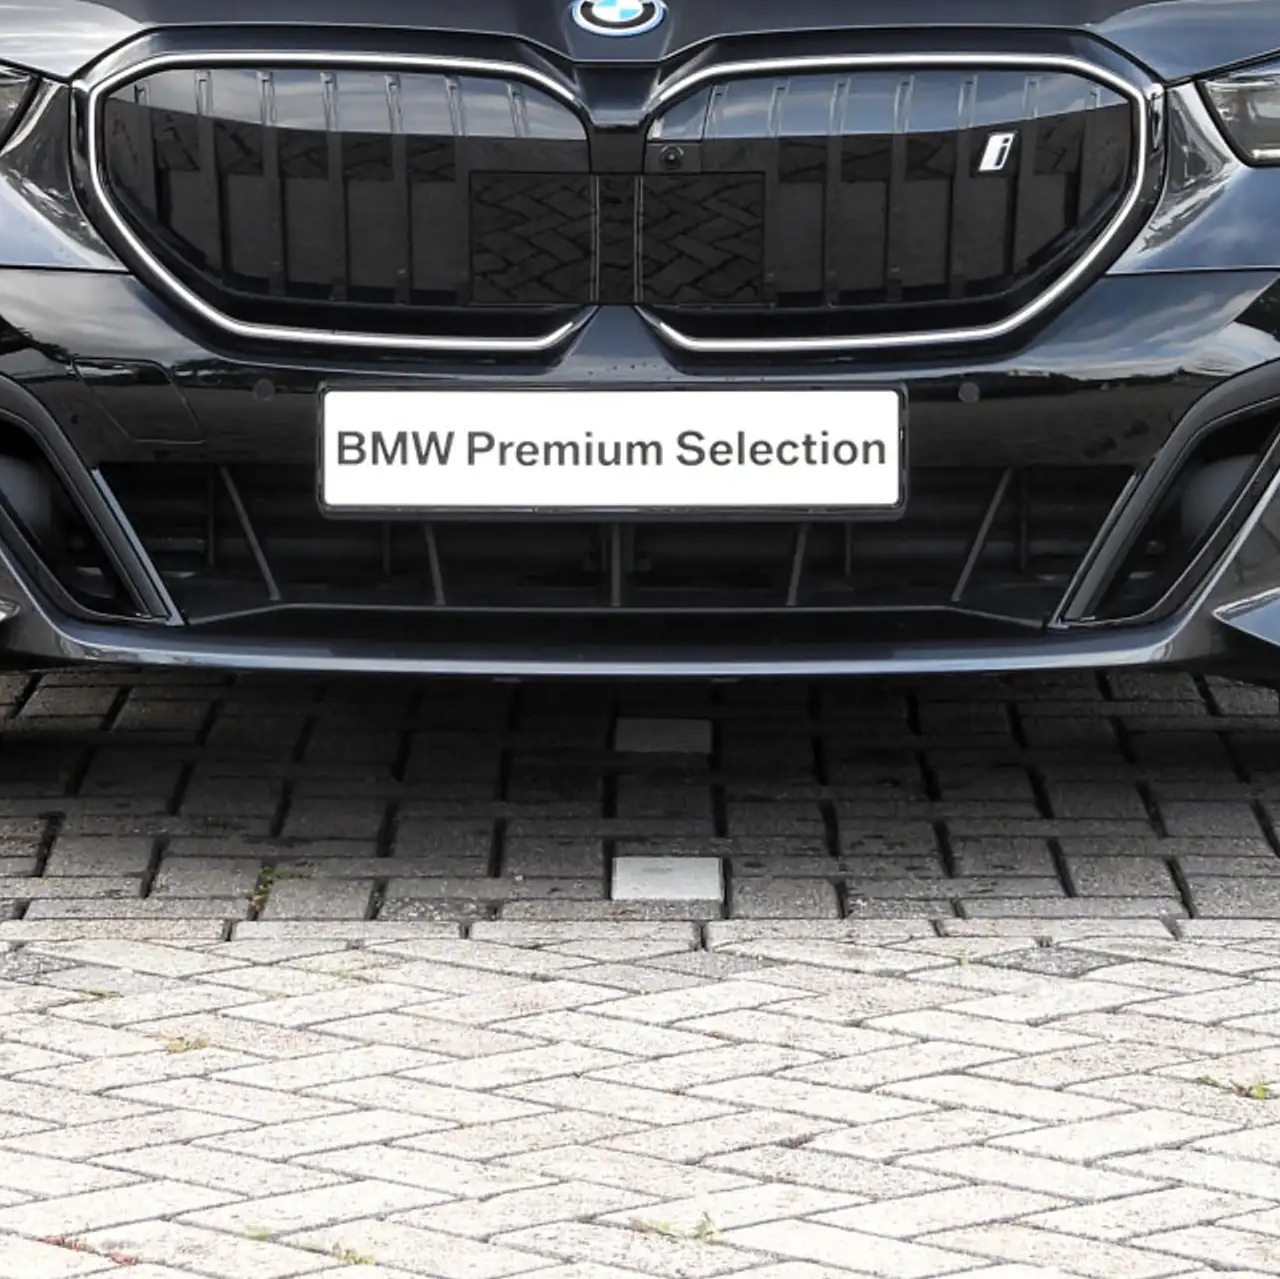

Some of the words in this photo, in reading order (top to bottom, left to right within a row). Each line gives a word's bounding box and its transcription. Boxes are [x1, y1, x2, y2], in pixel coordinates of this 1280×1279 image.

[337, 431, 455, 466] BMW
[467, 431, 663, 466] Premium
[676, 430, 886, 466] Selection
